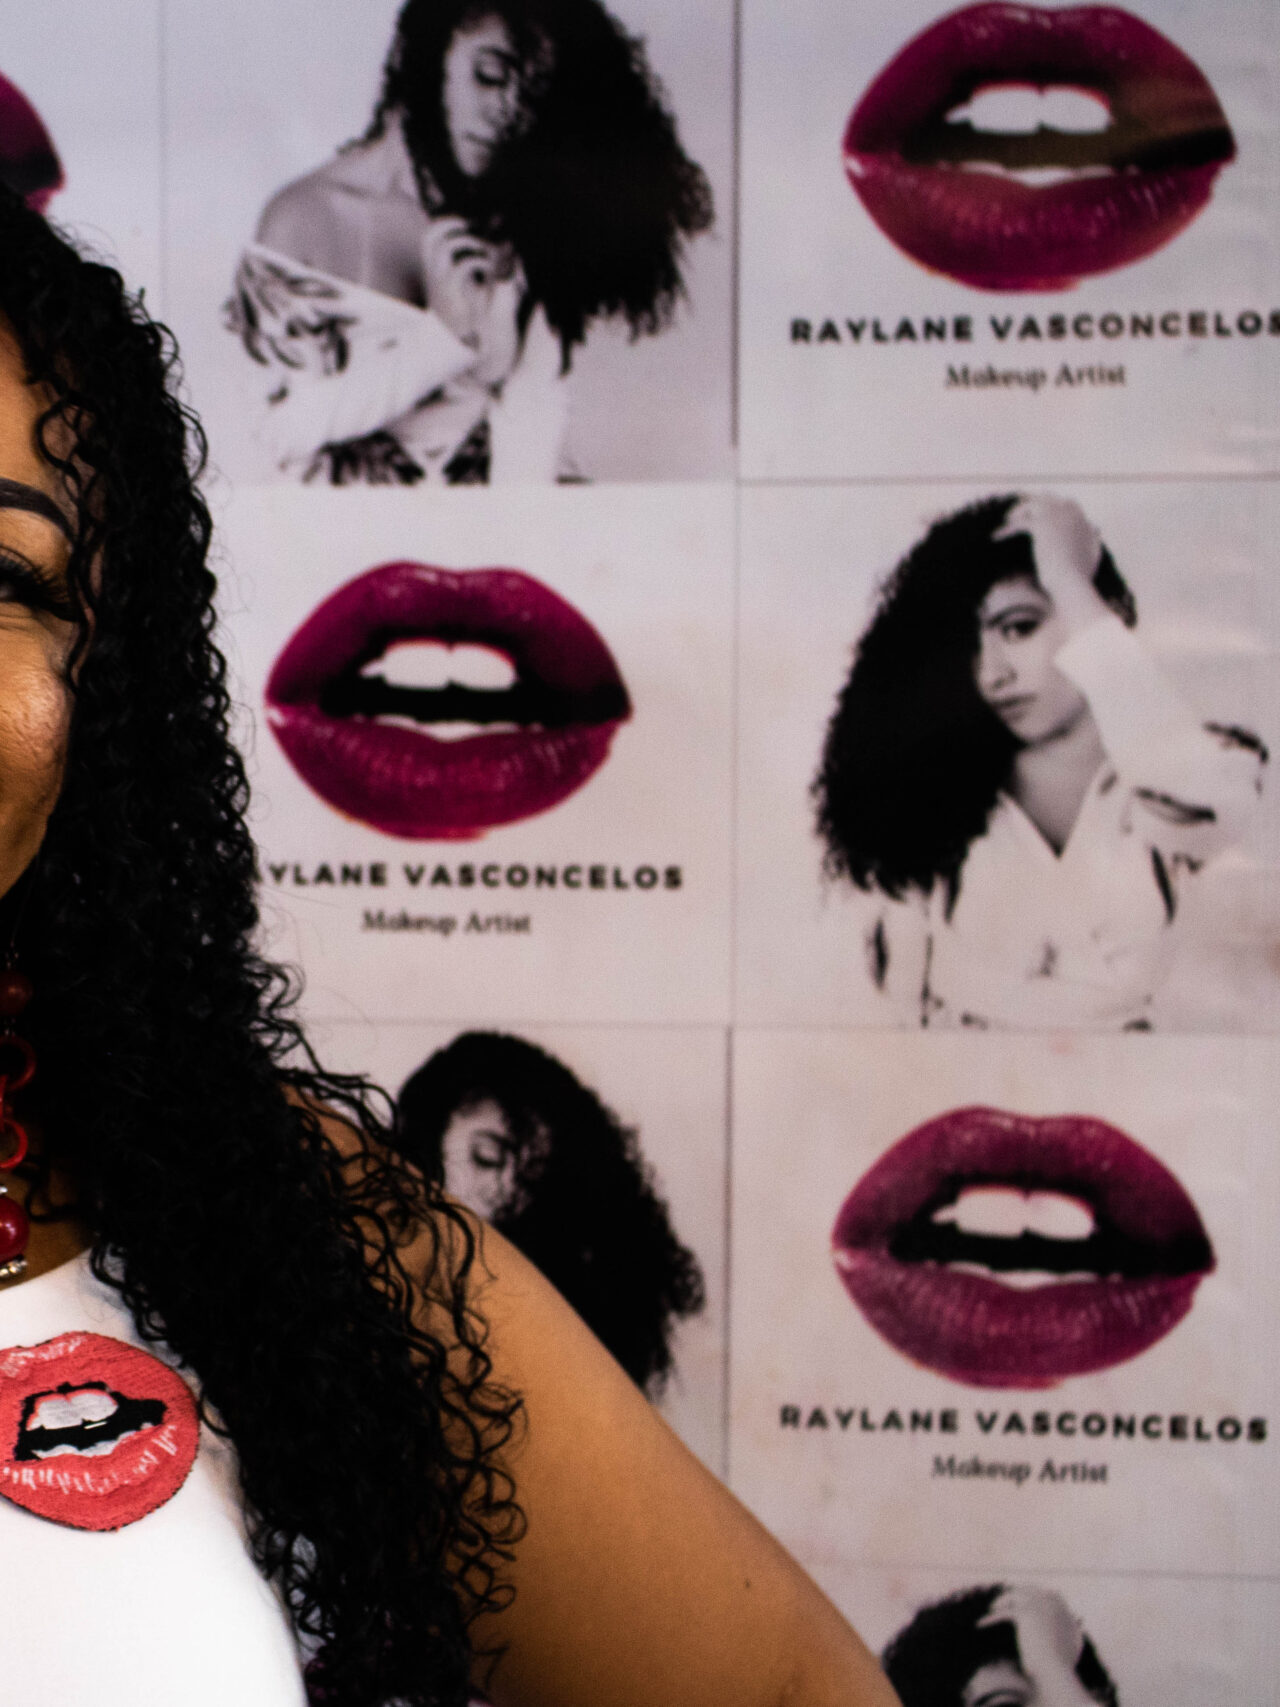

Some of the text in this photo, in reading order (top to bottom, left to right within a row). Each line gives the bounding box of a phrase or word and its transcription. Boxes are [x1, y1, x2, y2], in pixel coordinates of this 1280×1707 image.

[790, 316, 974, 344] RAYLANE
[945, 363, 1127, 394] Makeup Artist
[403, 863, 685, 890] VASCONCELOS
[361, 909, 533, 938] Makeup Artist
[780, 1405, 1268, 1443] RAYLANE VASCONCELOS
[931, 1455, 1109, 1485] Makeup Artist
